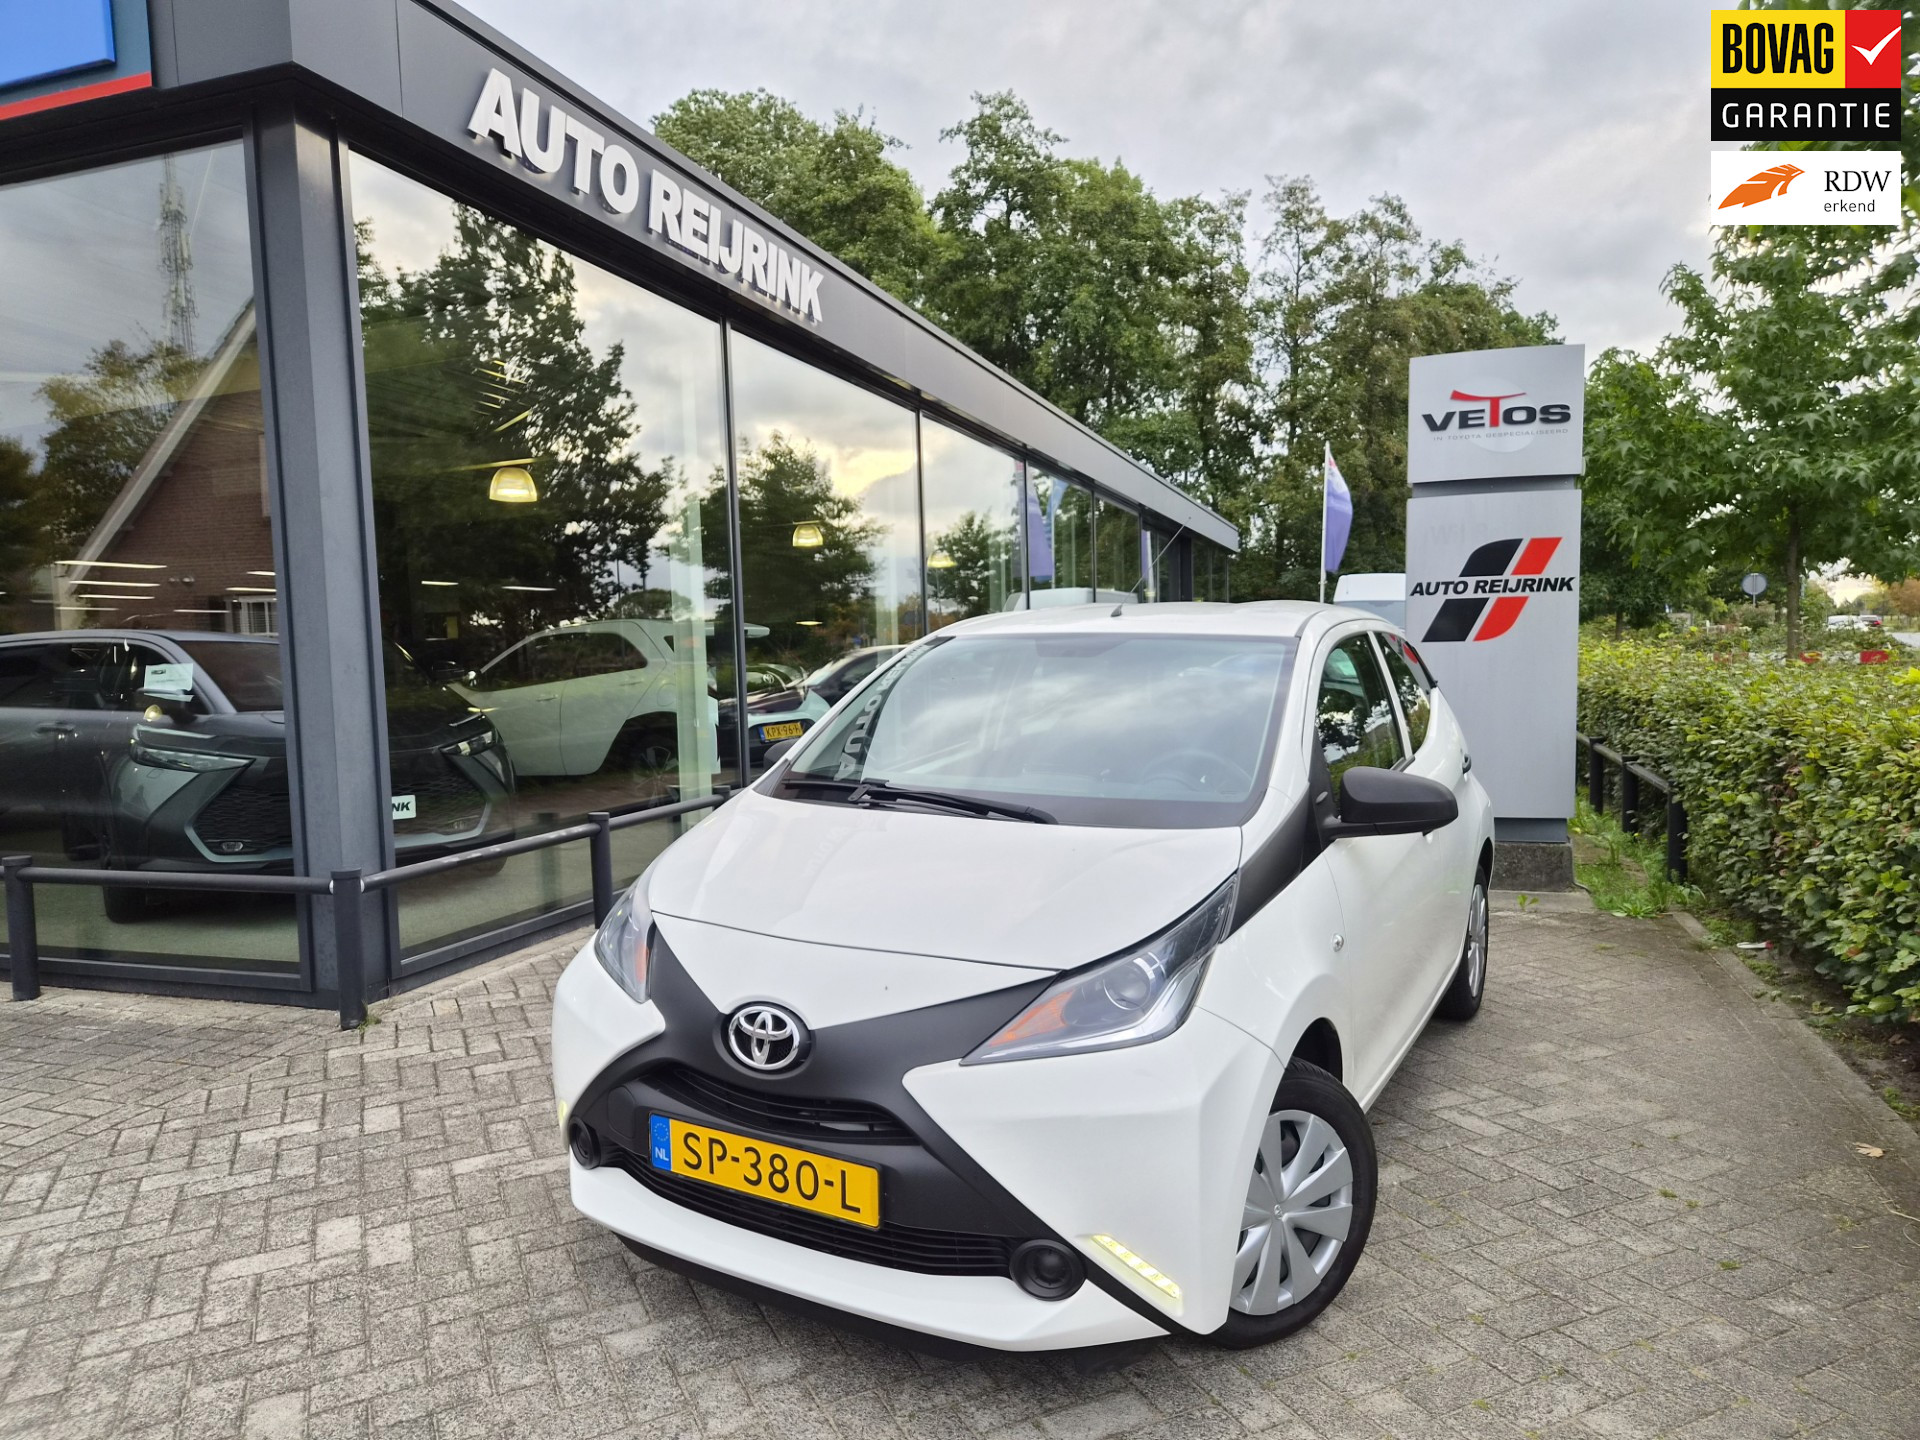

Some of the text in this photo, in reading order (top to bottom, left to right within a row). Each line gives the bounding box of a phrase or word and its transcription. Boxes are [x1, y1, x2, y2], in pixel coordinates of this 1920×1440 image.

[467, 67, 825, 323] AUTO REIJRINK
[1421, 389, 1572, 433] VETOS
[1448, 433, 1482, 441] TOYOTA
[1485, 428, 1569, 439] GESPECIALISEERD
[1409, 576, 1576, 598] AUTO REIJRINK
[655, 1146, 670, 1162] NL
[682, 1131, 861, 1214] SP-380-L
